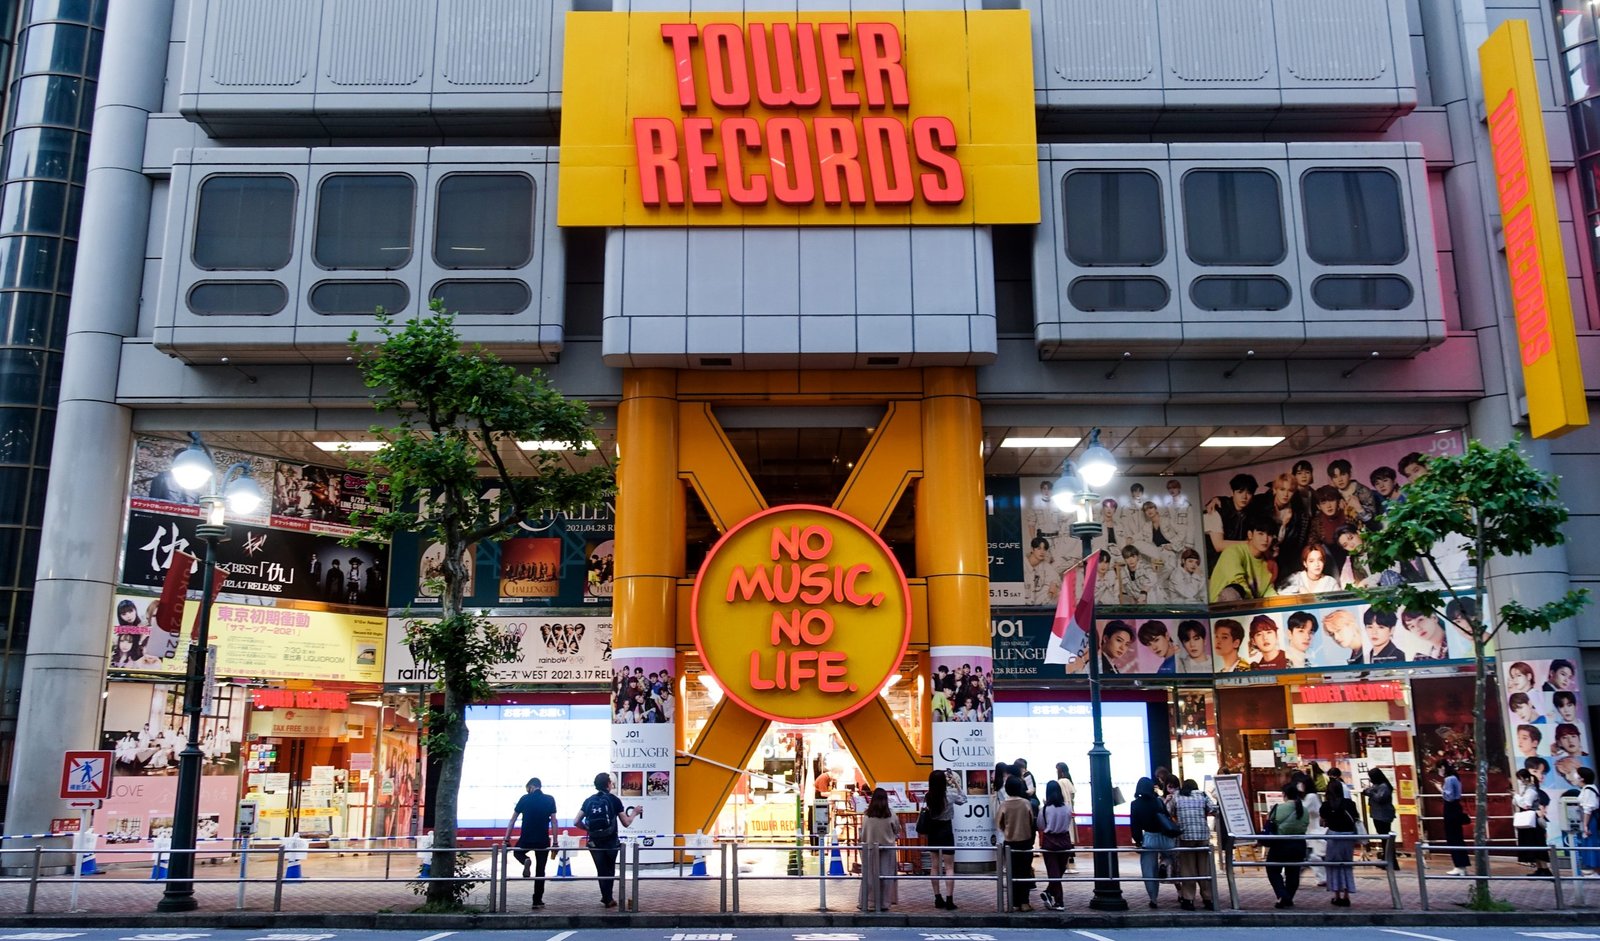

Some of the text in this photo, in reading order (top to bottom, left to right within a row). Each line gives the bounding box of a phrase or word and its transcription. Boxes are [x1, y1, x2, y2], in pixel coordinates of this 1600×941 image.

[660, 23, 909, 110] TOWER
[633, 116, 965, 207] RECORDS
[1490, 88, 1552, 367] TOWER RECORDS
[1429, 437, 1457, 452] JO1
[566, 524, 606, 532] 2021.04.28
[771, 524, 833, 561] NO
[247, 581, 283, 593] RELEASE
[726, 563, 885, 606] MUSIC,
[217, 606, 311, 628] 東京初期衝動
[771, 609, 834, 646] NO
[164, 616, 182, 660] 2020
[551, 670, 593, 680] 2021.3.17
[751, 650, 858, 692] LIFE.
[1005, 667, 1038, 675] RELEASE
[625, 730, 640, 738] JO1
[969, 729, 983, 737] JO1
[964, 804, 990, 819] JO1
